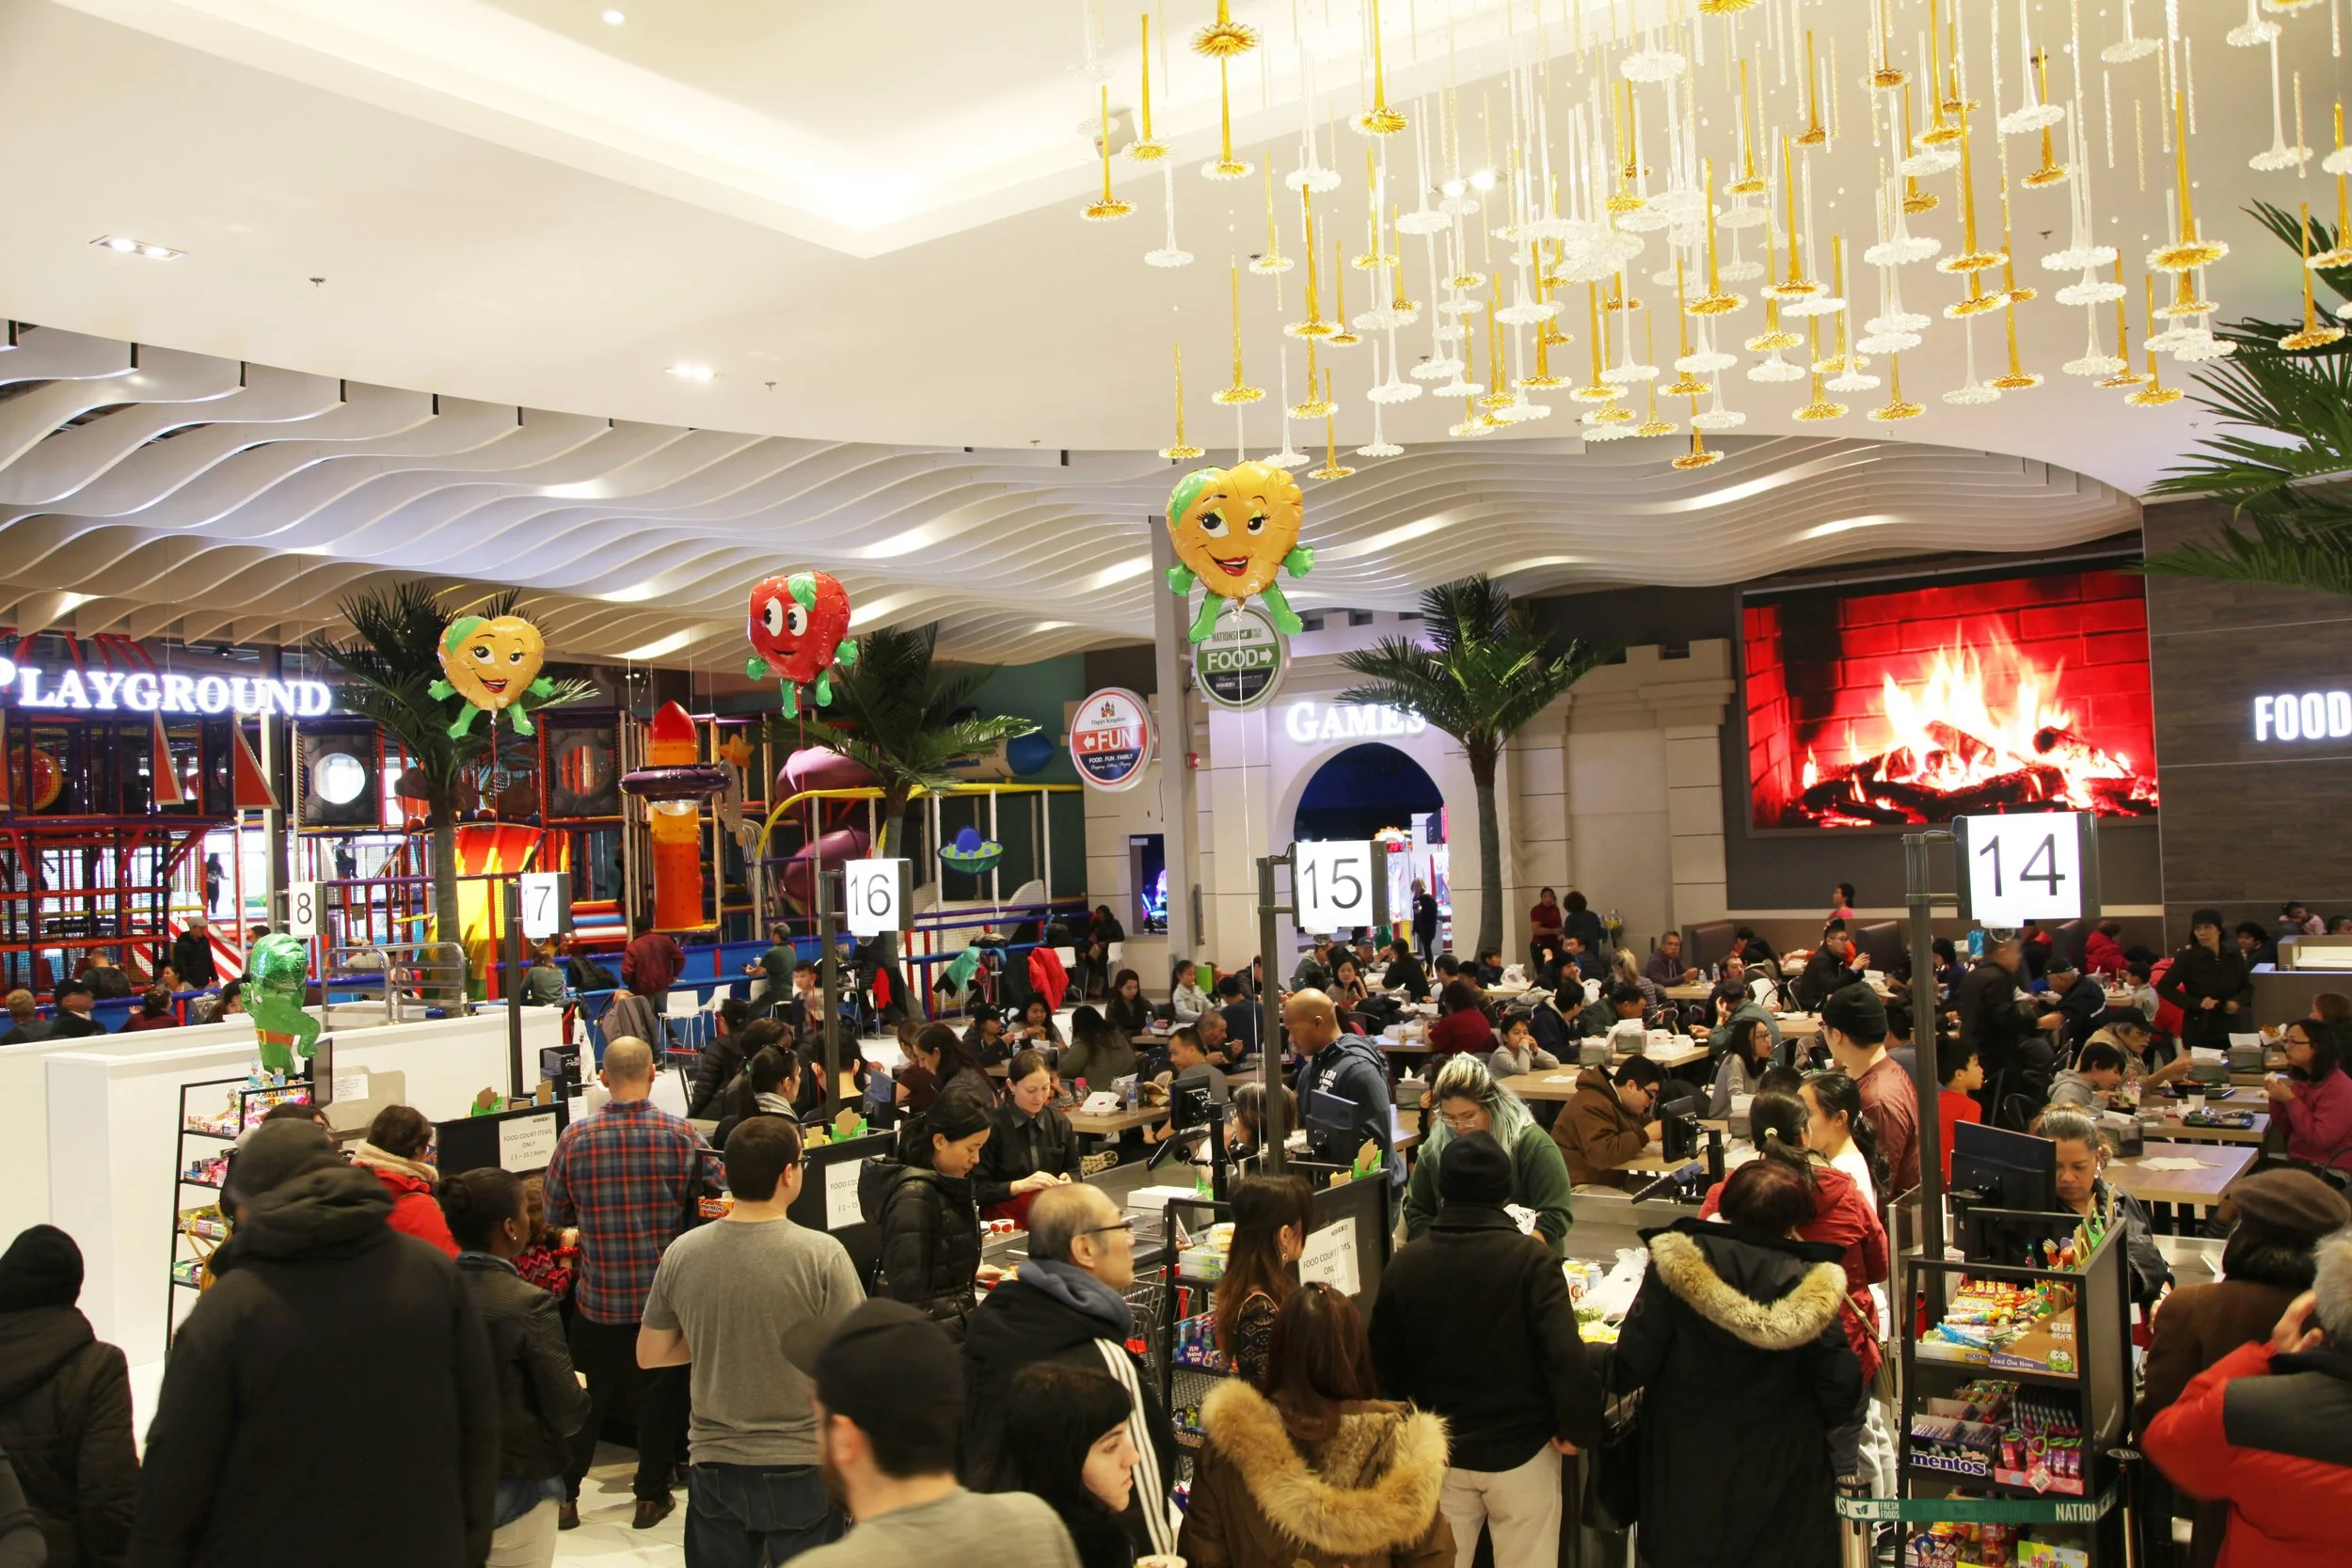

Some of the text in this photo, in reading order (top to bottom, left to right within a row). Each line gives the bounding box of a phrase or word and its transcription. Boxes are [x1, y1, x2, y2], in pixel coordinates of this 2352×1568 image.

[1207, 649, 1259, 671] FOOD
[1285, 702, 1426, 742] GAMES
[2254, 691, 2352, 741] FOOD
[1097, 728, 1135, 751] FUN
[1979, 833, 2066, 897] 14
[850, 874, 891, 916] 16
[1304, 858, 1362, 909] 15
[519, 1131, 536, 1140] COURT
[1304, 1257, 1318, 1269] FOOD
[1320, 1248, 1337, 1262] COURT
[1990, 1356, 2005, 1365] Feed
[1910, 1452, 1987, 1476] mentos
[1880, 1501, 1899, 1511] FRESH
[1881, 1511, 1900, 1519] FOODS
